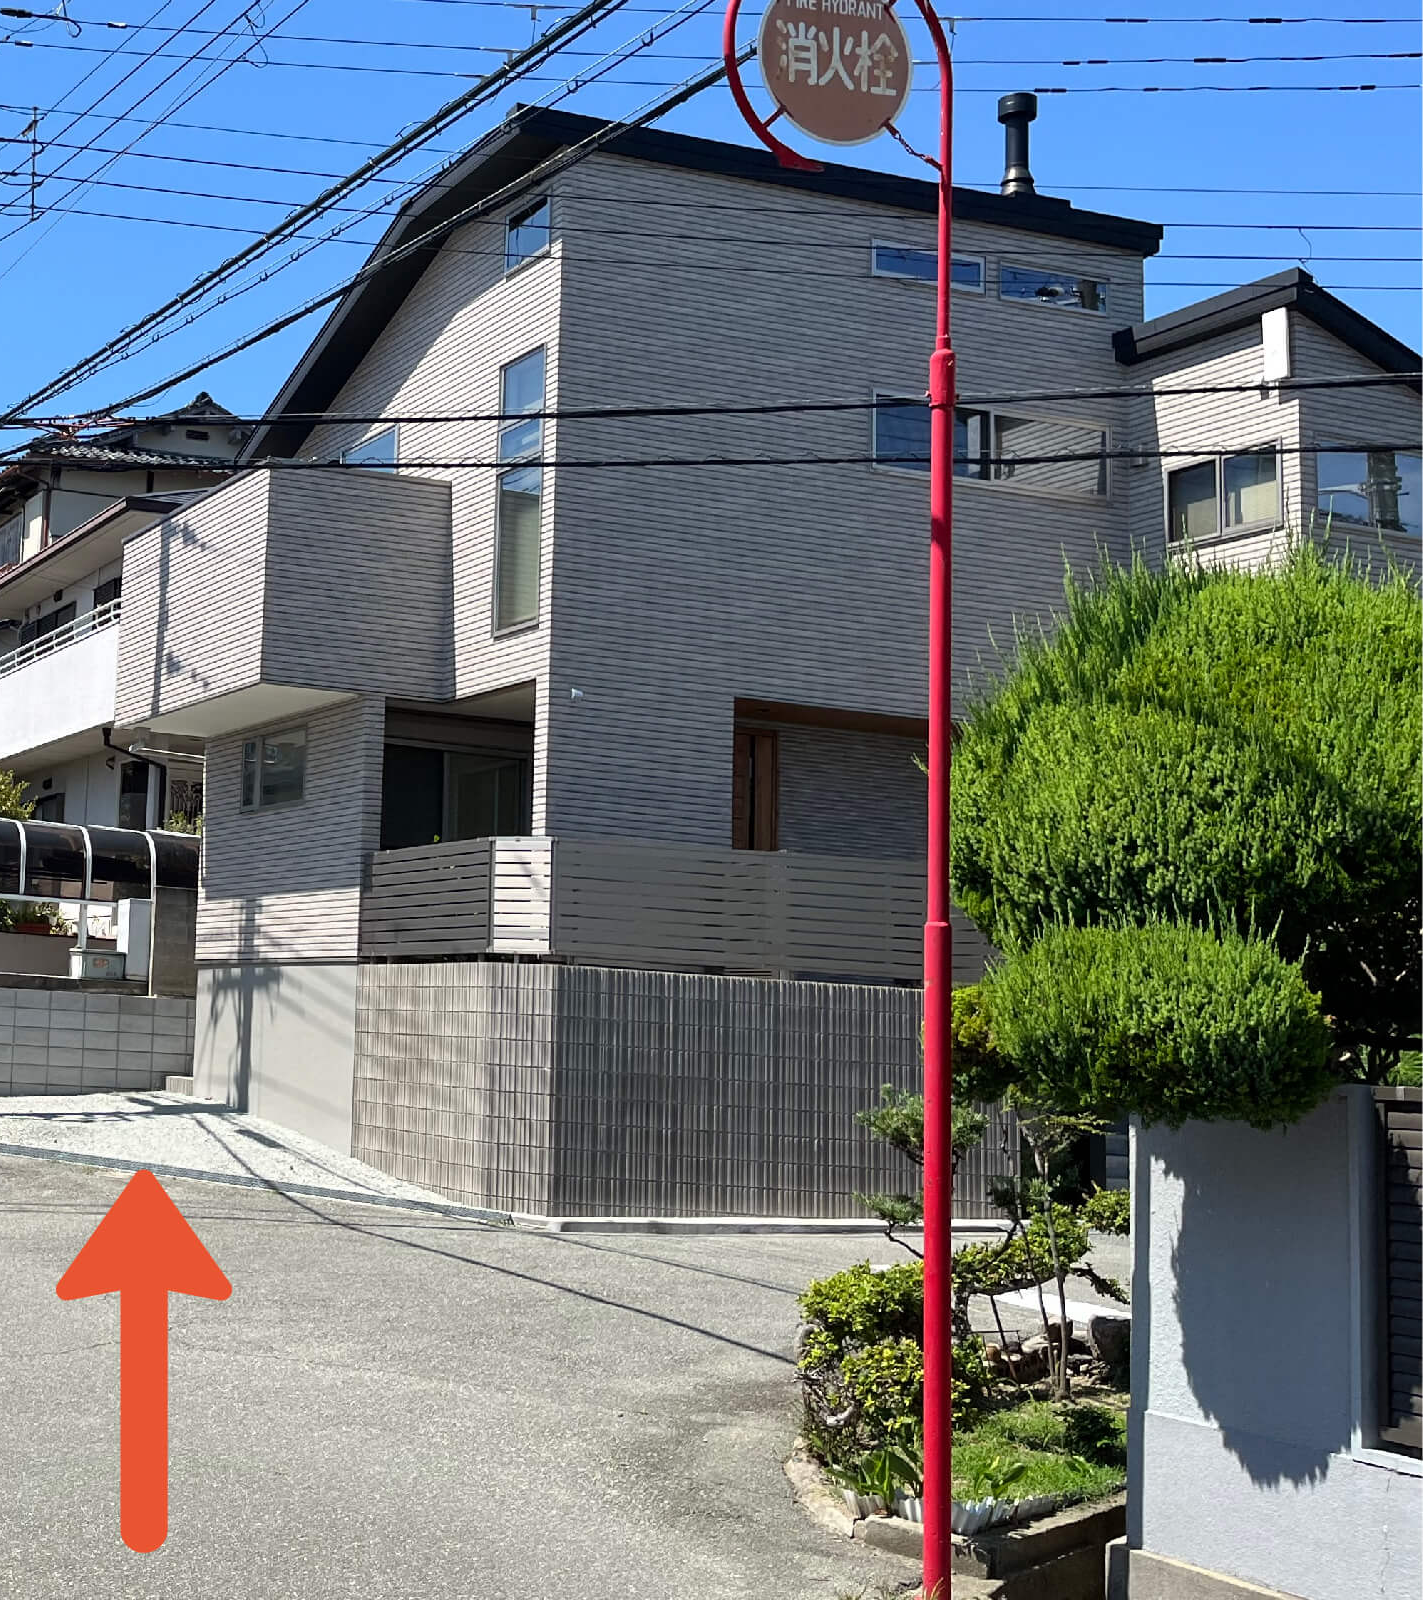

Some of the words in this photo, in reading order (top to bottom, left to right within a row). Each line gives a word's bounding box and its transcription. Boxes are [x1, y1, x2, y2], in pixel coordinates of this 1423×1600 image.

[822, 0, 883, 20] HYDRANT
[777, 19, 897, 96] 消火栓
